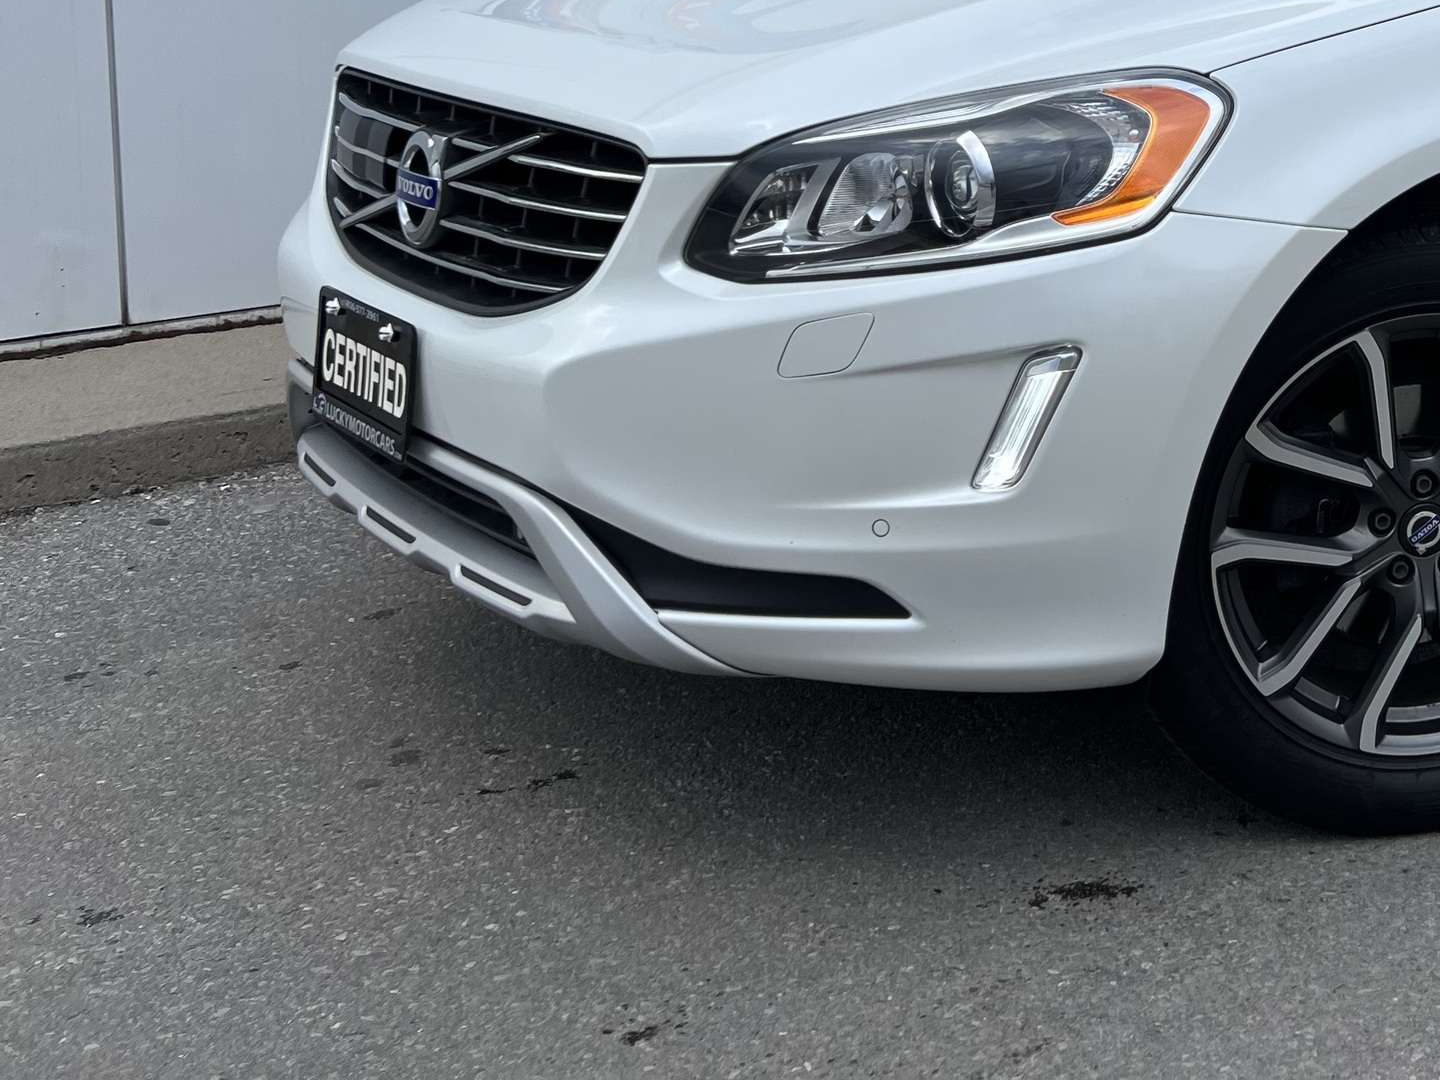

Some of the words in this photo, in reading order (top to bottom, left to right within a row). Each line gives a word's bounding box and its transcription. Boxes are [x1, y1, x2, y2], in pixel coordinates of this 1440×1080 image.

[398, 176, 434, 200] VOLVO
[322, 328, 407, 418] CERTIFIED
[1411, 518, 1440, 543] VOLVO
